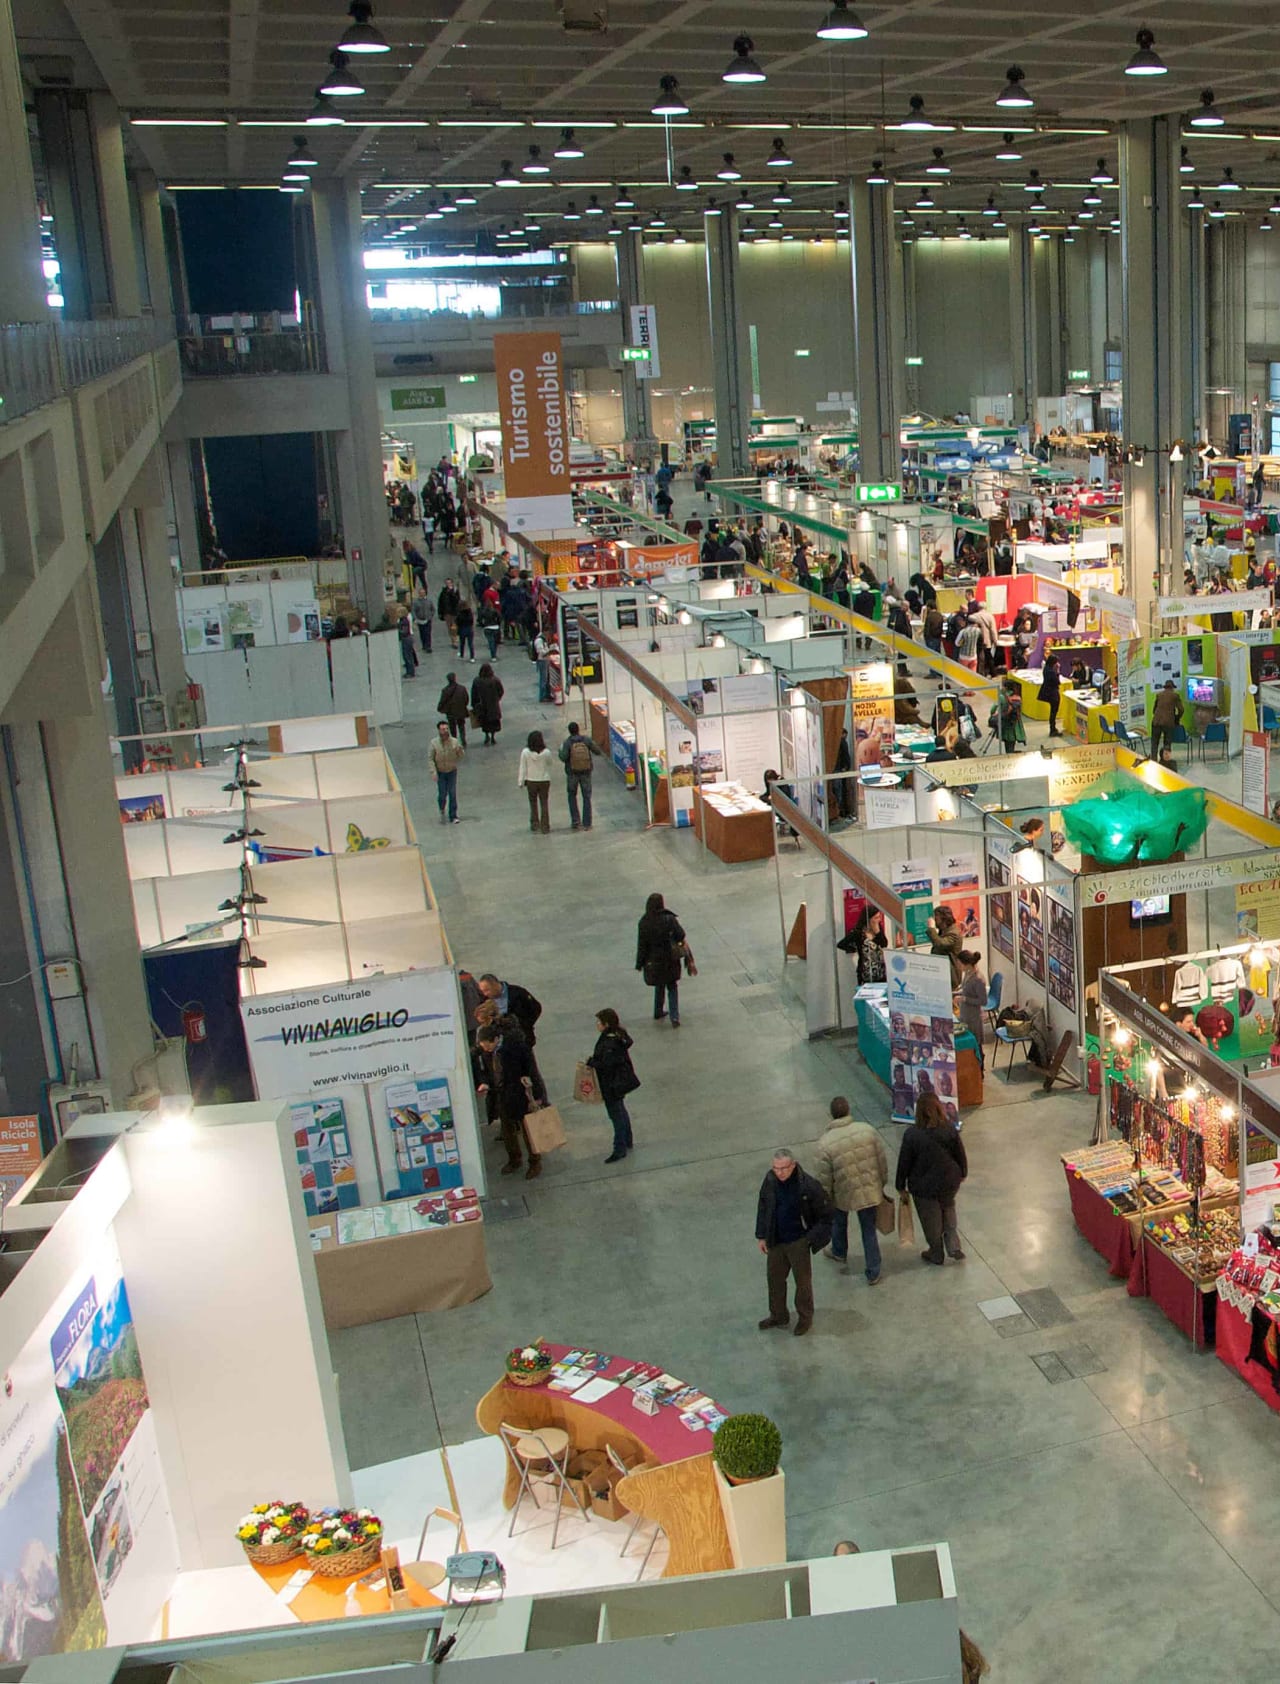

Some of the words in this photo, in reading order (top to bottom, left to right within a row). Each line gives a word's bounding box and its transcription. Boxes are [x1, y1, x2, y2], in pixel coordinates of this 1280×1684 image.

[507, 368, 530, 463] Turismo
[536, 351, 565, 475] sostenibile
[634, 552, 693, 574] demeter
[1118, 866, 1233, 891] agrobiodiversità
[247, 997, 320, 1016] Associazione
[322, 989, 372, 1004] Culturale
[281, 1008, 409, 1046] VIVINAVIGLIO
[312, 1063, 411, 1087] www.vivinaviglio.it
[1, 1129, 36, 1140] Riciclo
[9, 1119, 35, 1129] Isola
[68, 1293, 97, 1338] FLORA
